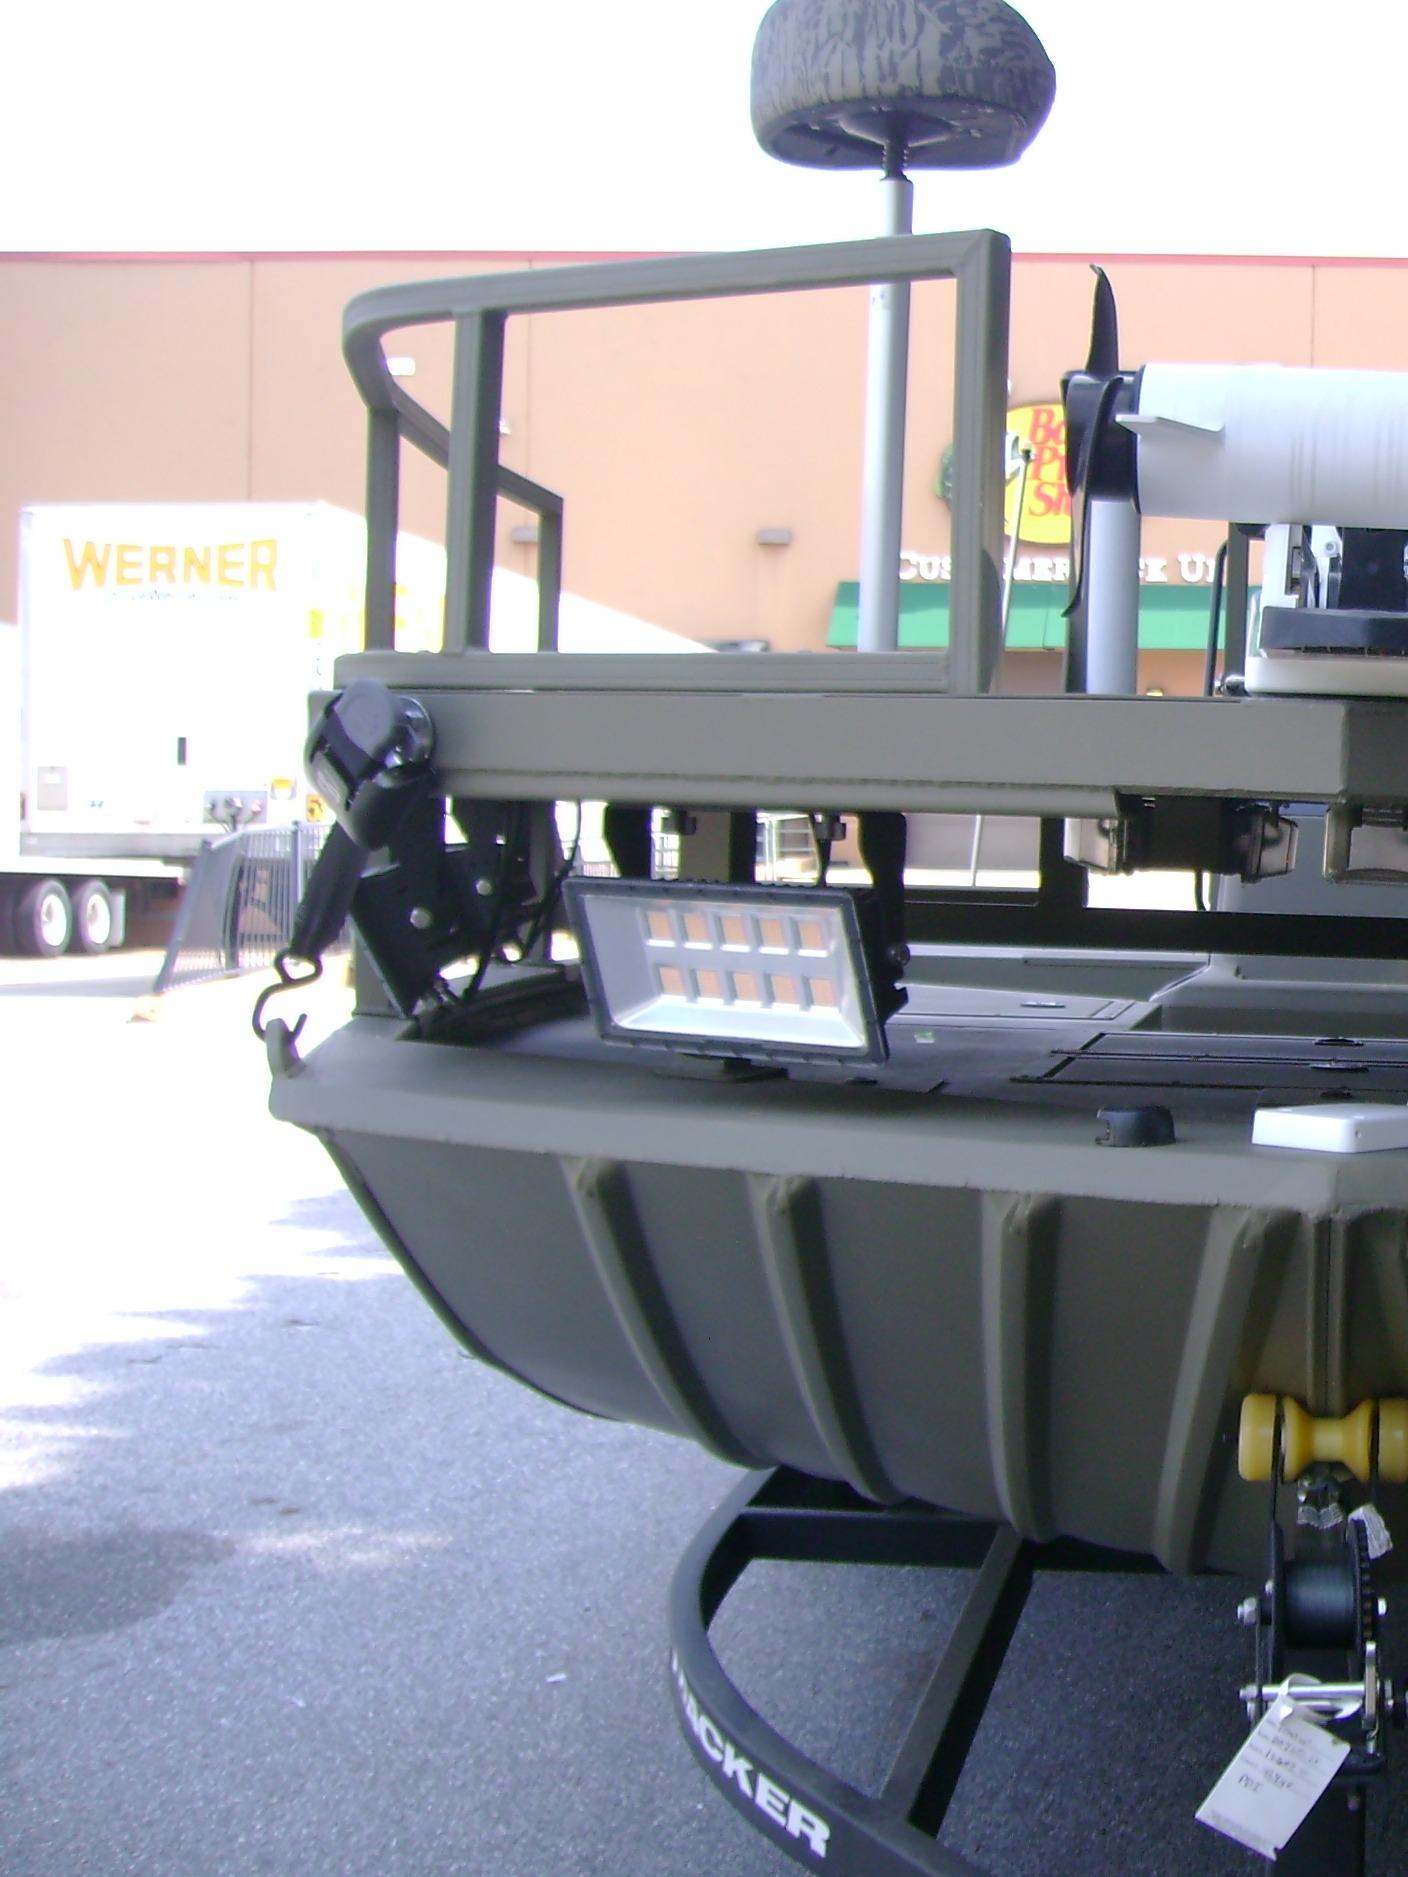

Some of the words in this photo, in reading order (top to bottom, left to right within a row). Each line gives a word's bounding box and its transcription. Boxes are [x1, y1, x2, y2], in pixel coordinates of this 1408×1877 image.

[1030, 407, 1067, 445] Ba
[63, 538, 277, 591] WERNER
[671, 1649, 831, 1858] ACKER
